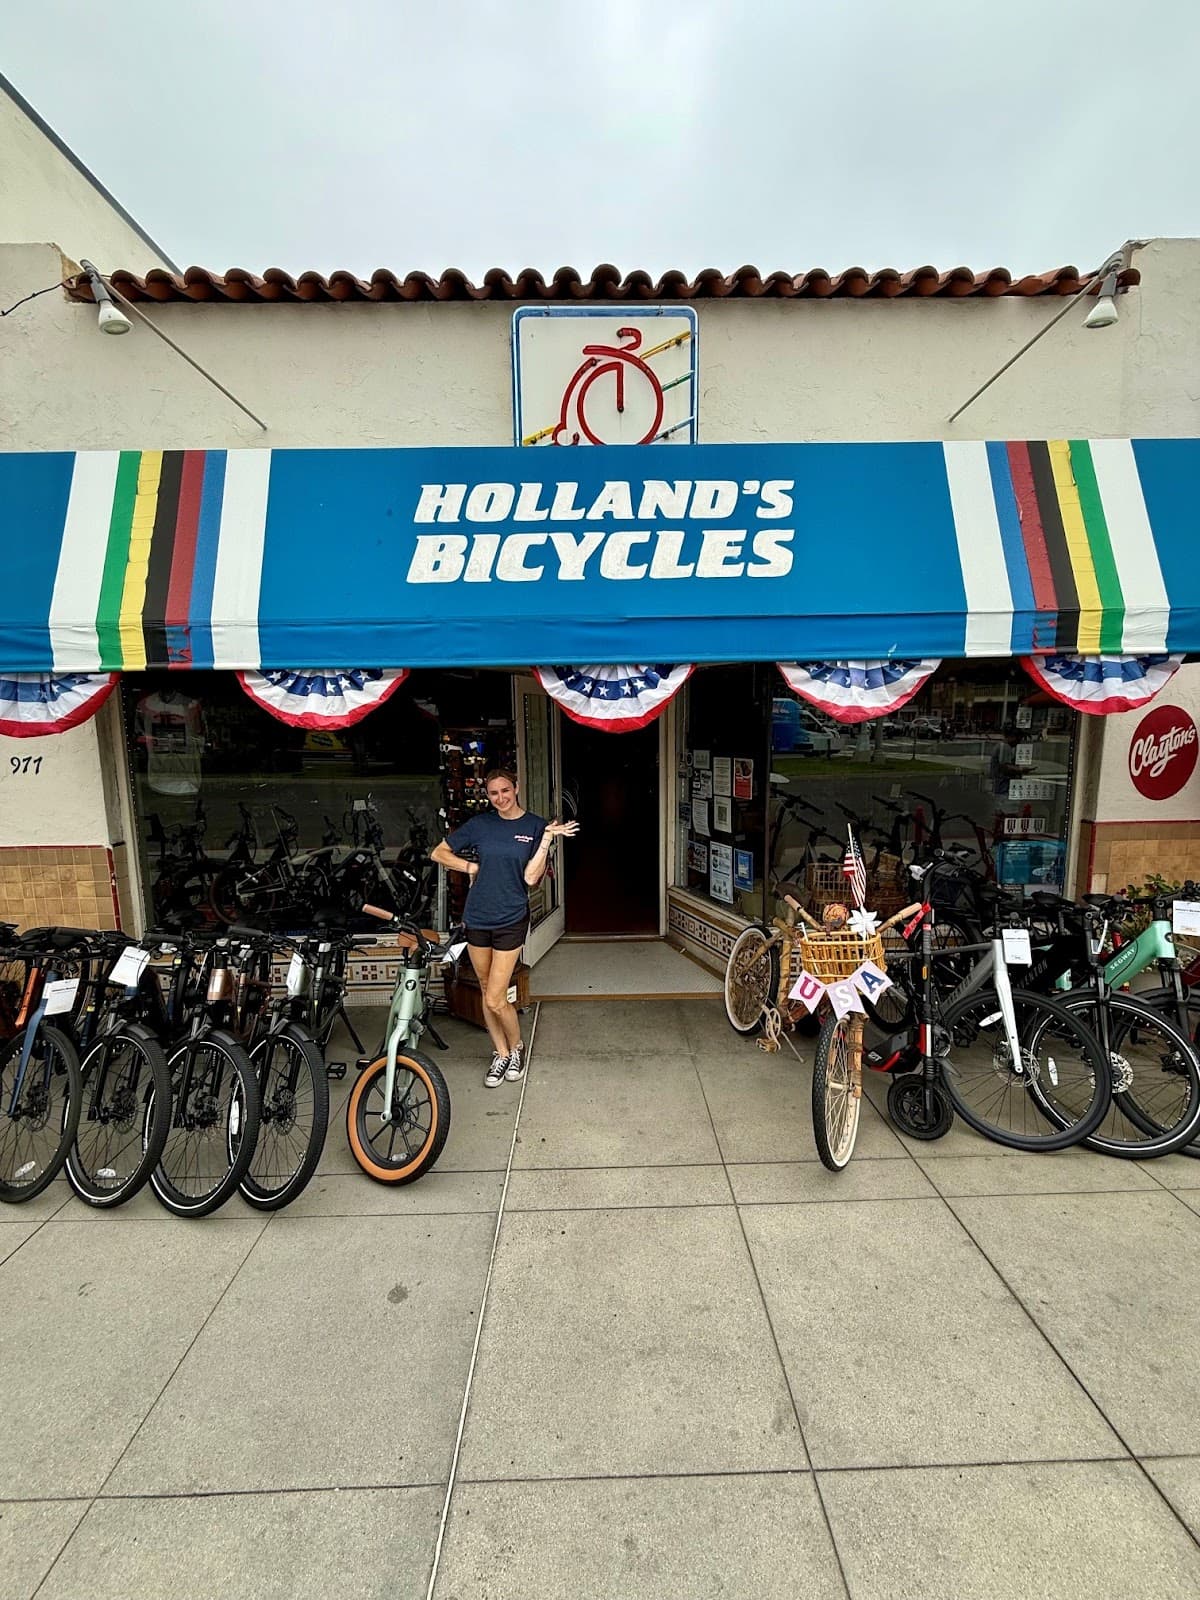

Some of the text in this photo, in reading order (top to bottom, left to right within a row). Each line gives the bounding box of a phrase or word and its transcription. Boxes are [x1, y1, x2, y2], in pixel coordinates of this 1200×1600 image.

[413, 479, 795, 523] HOLLAND'S
[406, 529, 795, 583] BICYCLES
[1130, 724, 1196, 778] Clayton's
[1109, 947, 1136, 971] SEGWAY
